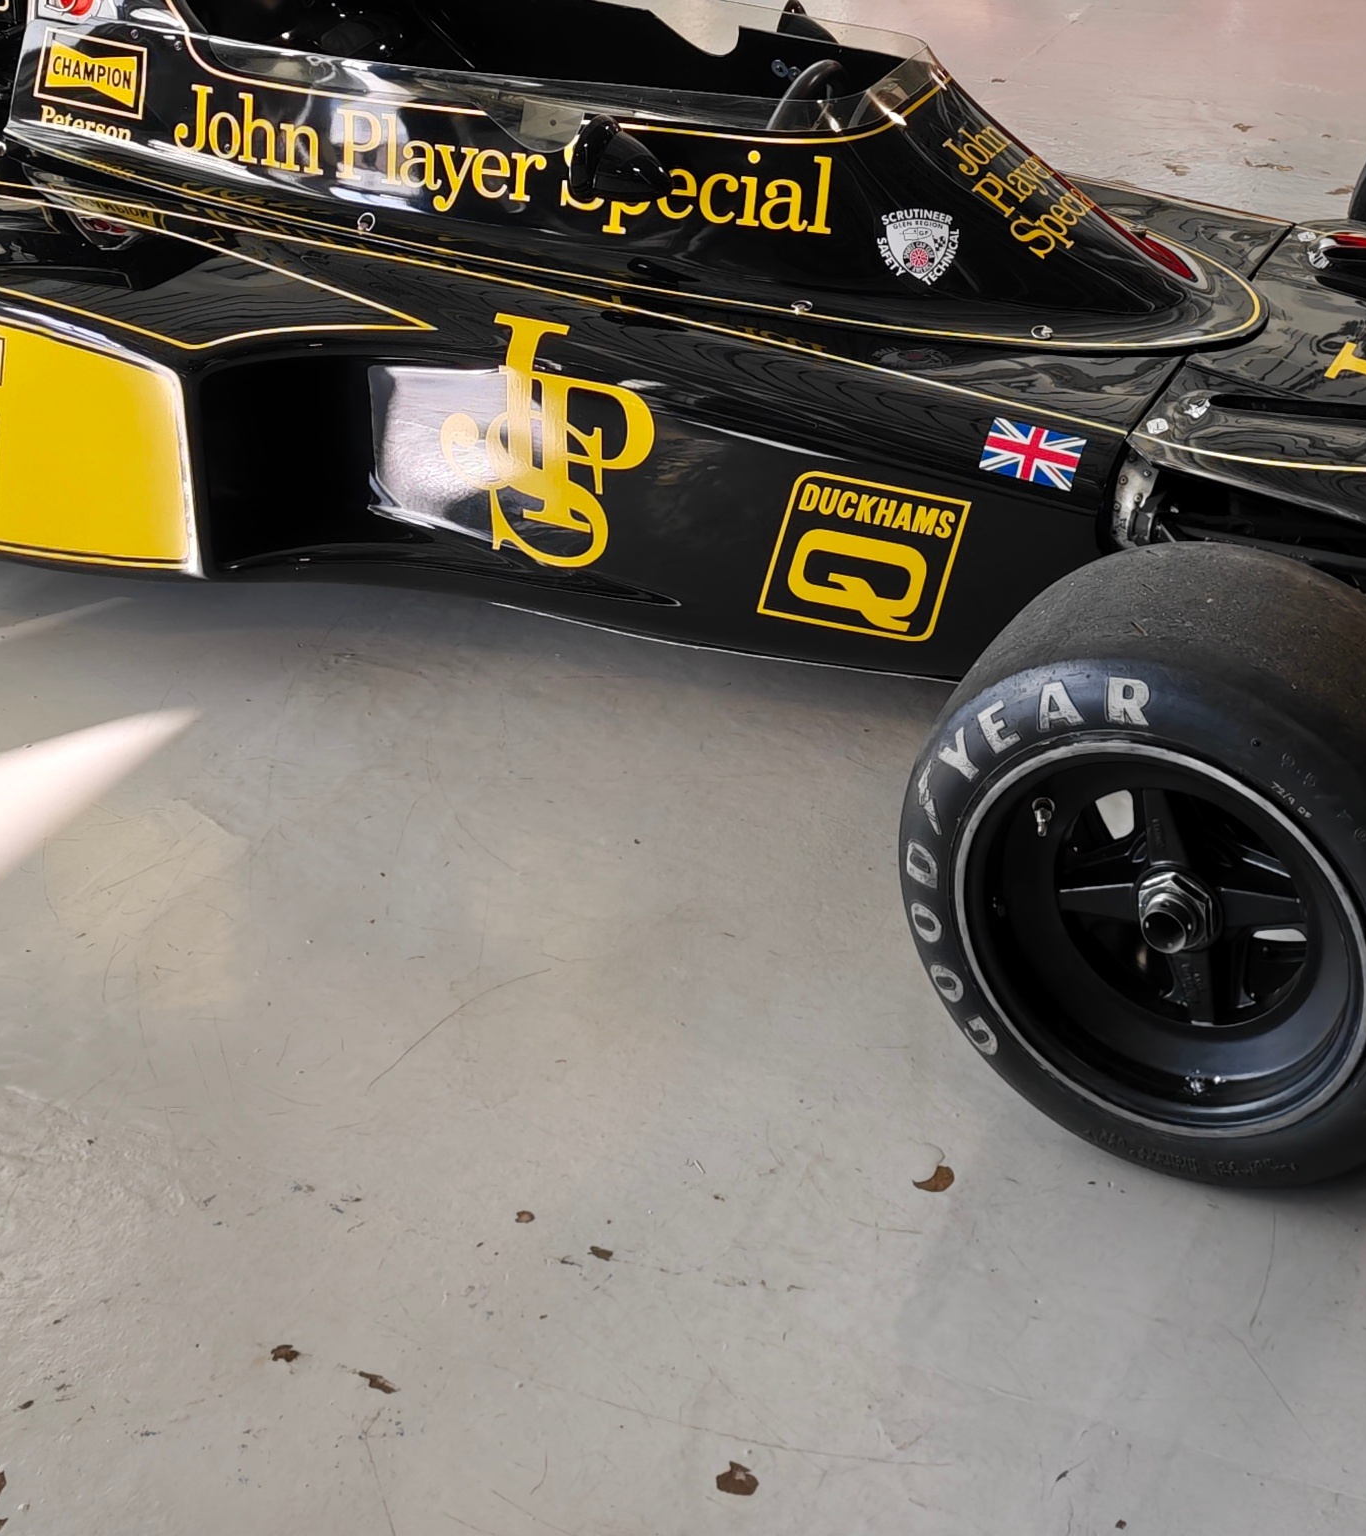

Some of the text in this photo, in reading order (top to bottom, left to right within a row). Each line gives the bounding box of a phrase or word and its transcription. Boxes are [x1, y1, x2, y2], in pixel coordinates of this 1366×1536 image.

[53, 56, 132, 90] CHAMPION
[40, 105, 132, 141] Peterson
[173, 83, 324, 178] John
[334, 109, 546, 213] Player
[942, 125, 1012, 176] John
[881, 208, 953, 225] SCRUTINEER
[893, 220, 944, 229] GLEN REGION
[1010, 188, 1094, 260] Specia
[877, 237, 906, 277] SAFETY
[922, 228, 960, 286] TECHNICAL
[797, 482, 956, 539] DUCKHAMS
[787, 529, 928, 632] Q
